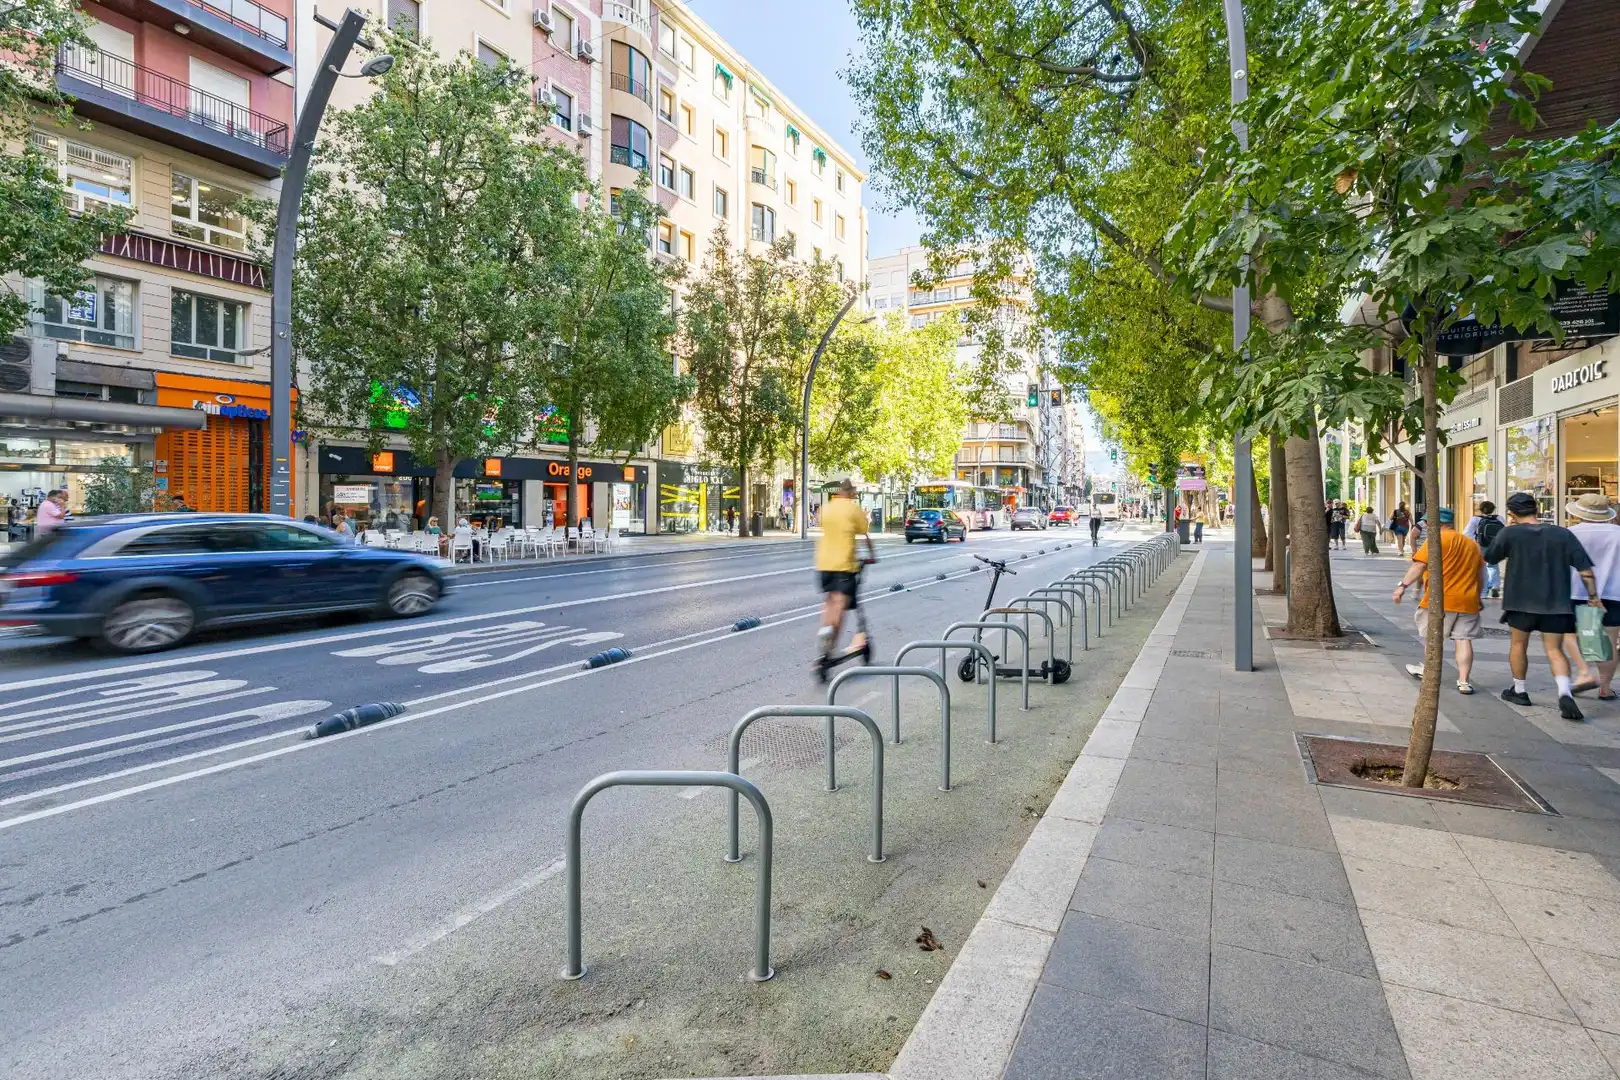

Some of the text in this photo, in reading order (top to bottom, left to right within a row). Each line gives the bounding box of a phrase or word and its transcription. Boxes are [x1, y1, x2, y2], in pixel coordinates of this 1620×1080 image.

[1437, 329, 1505, 341] TERIORISMO
[1552, 360, 1604, 394] PARFOIS
[549, 461, 592, 479] Orage
[331, 620, 624, 674] BUS
